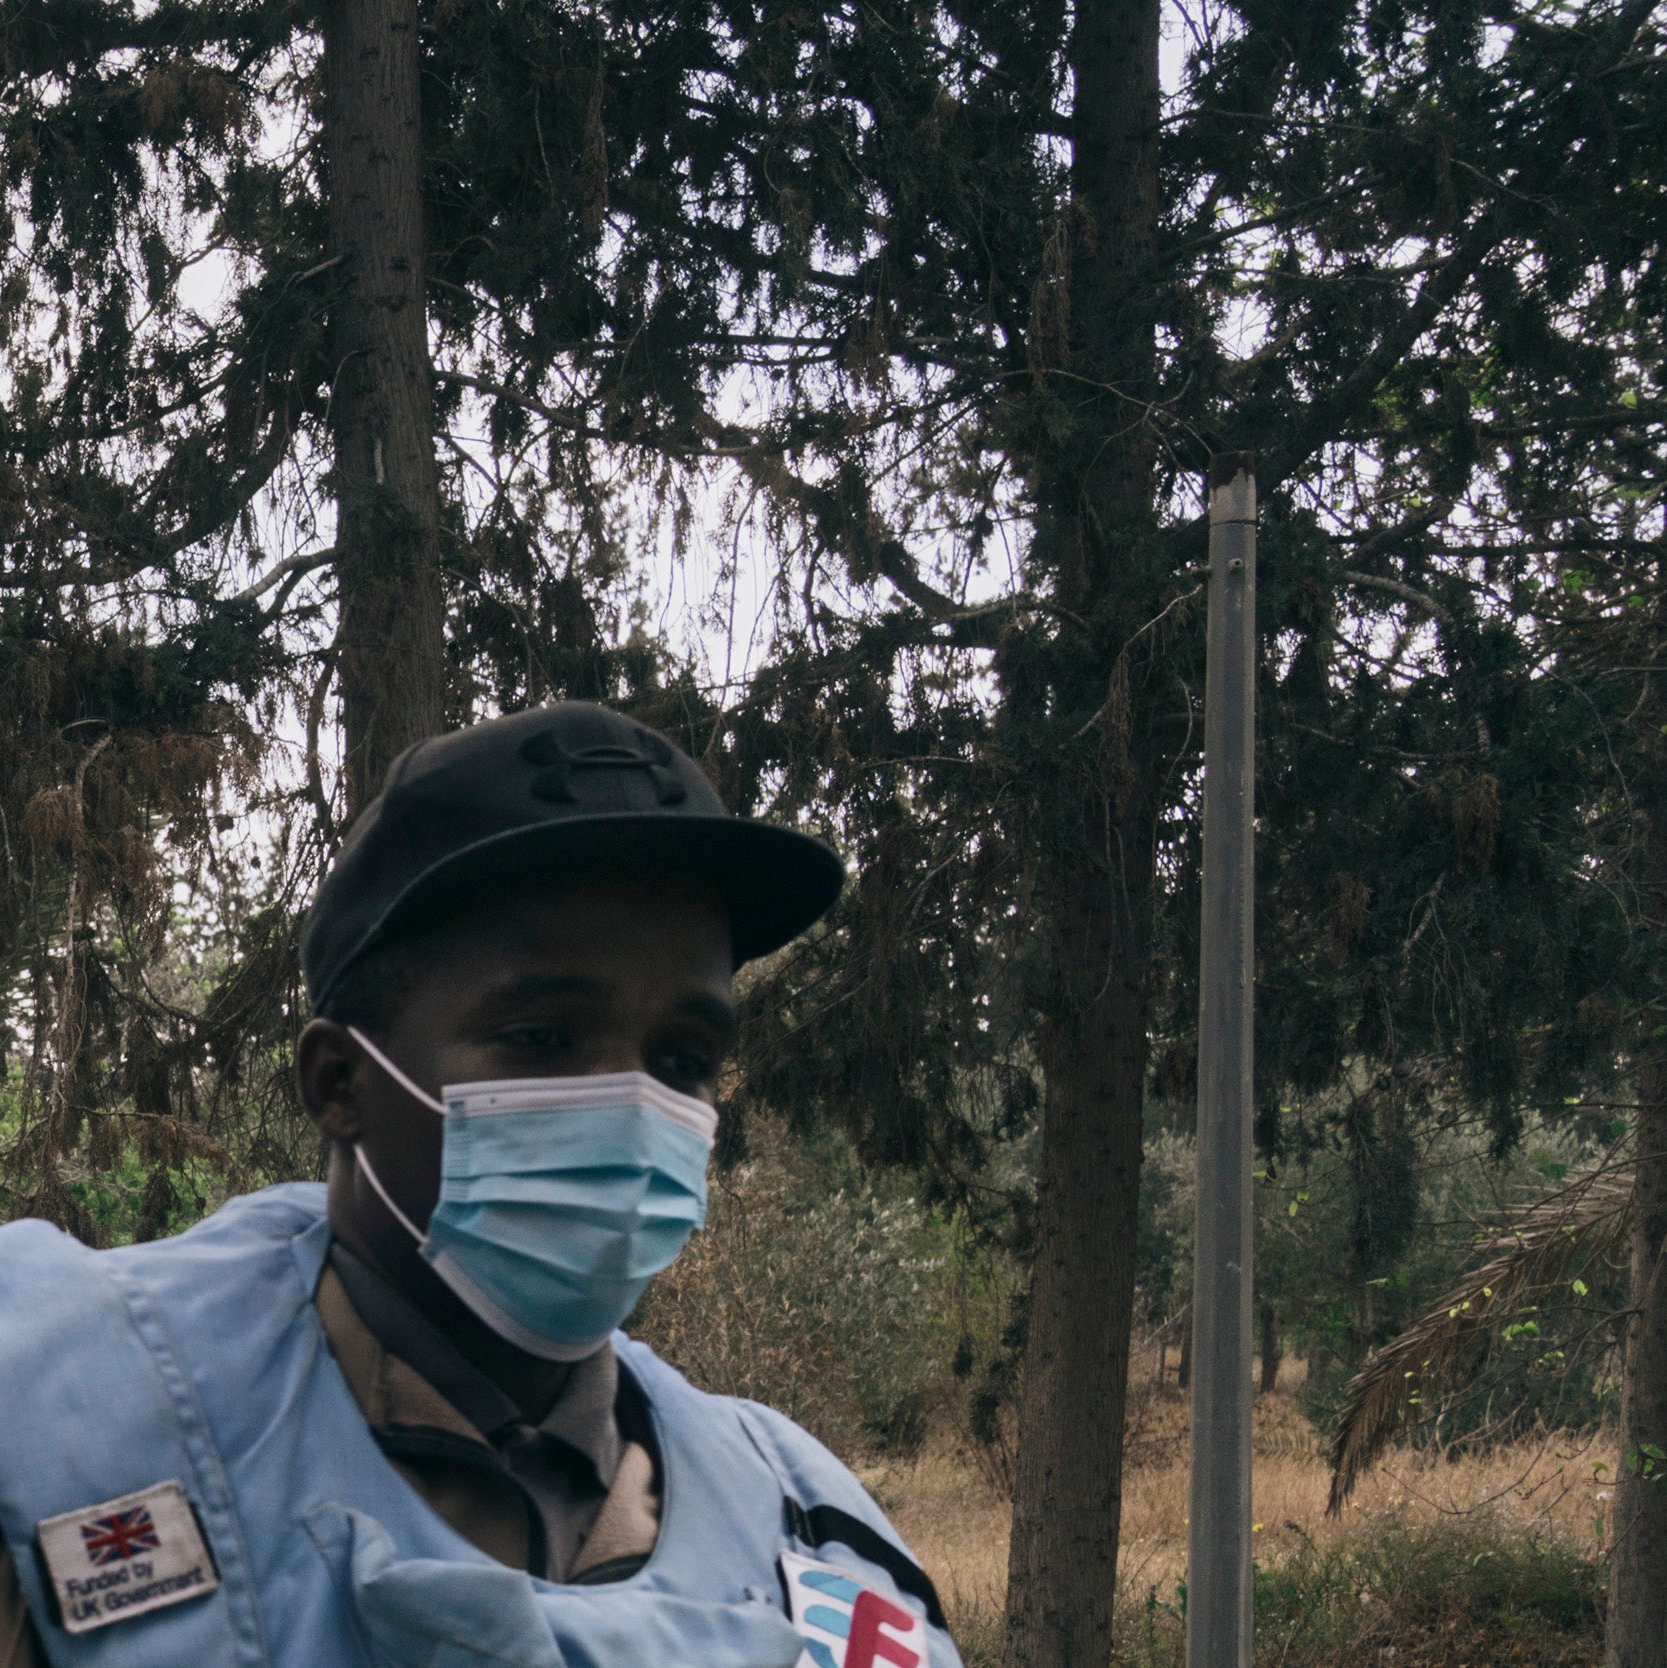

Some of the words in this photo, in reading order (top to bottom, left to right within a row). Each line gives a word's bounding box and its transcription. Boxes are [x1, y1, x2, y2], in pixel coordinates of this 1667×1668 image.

[66, 1565, 129, 1598] Funded
[132, 1561, 153, 1580] by
[71, 1598, 102, 1621] UK
[105, 1566, 204, 1612] Government
